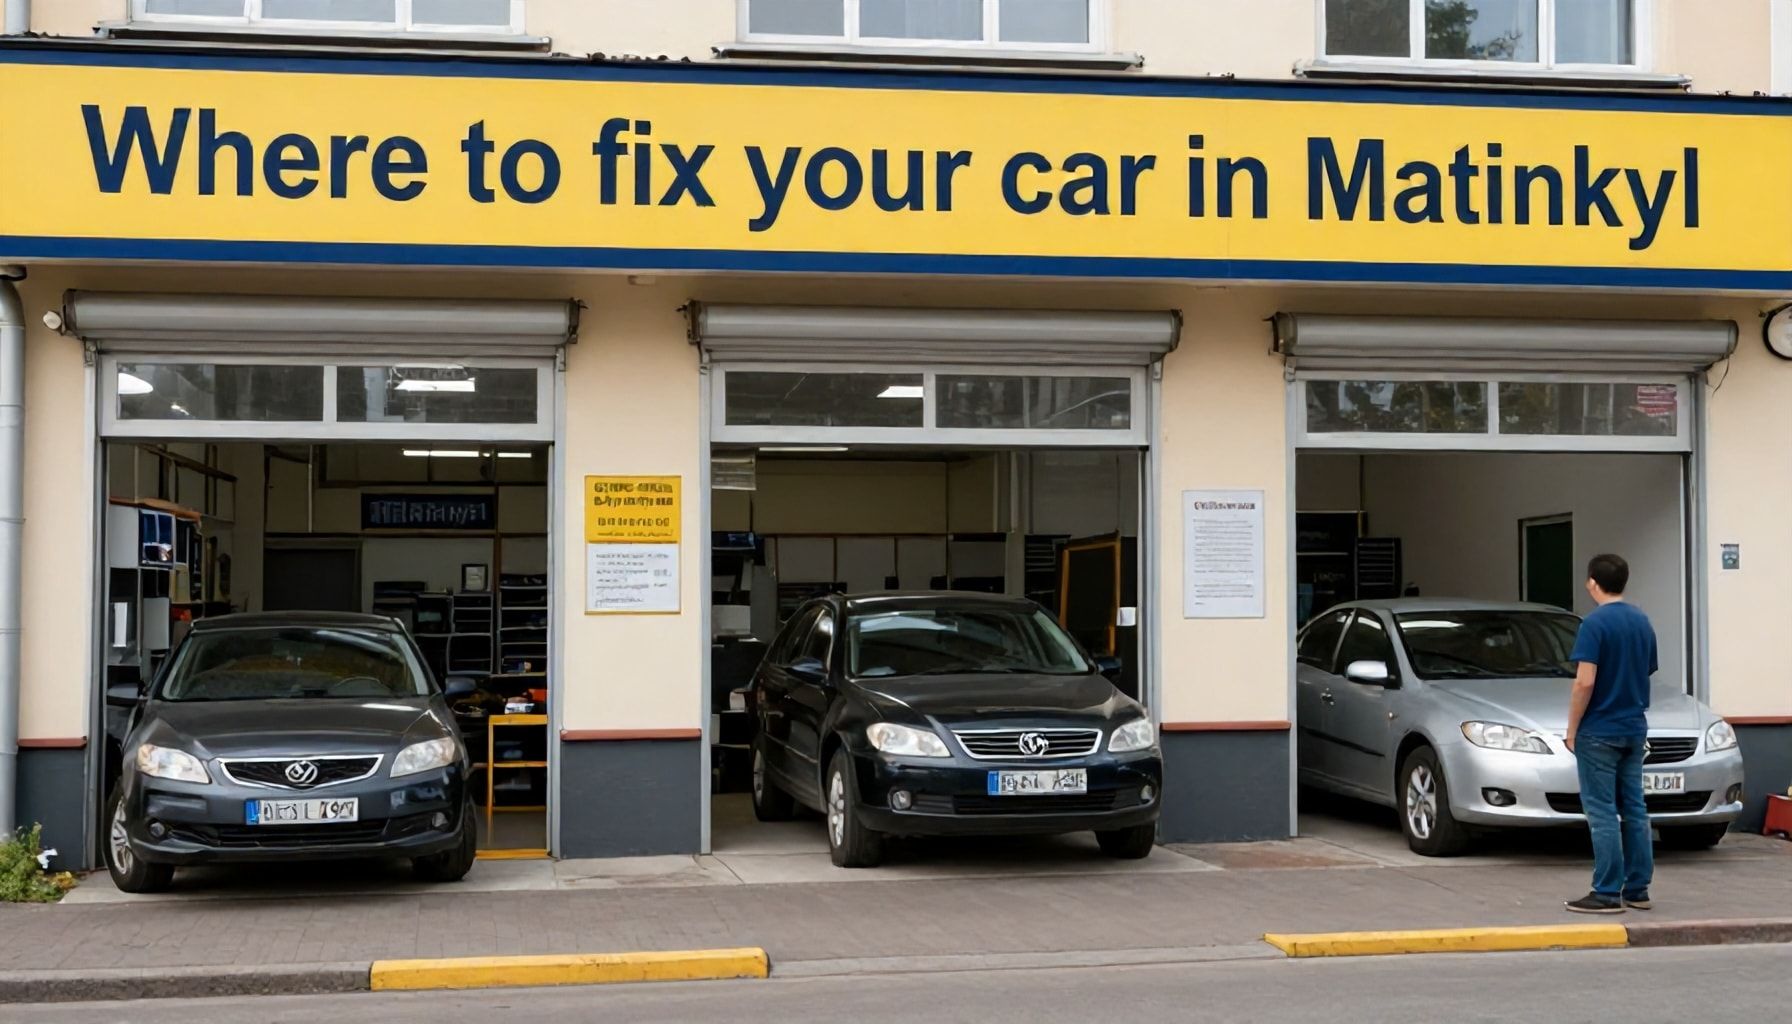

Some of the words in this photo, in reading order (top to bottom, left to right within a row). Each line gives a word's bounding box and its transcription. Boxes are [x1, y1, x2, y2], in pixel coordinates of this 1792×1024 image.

[81, 105, 427, 204] Where
[461, 120, 560, 206] to
[593, 118, 715, 208] fix
[744, 146, 972, 232] your
[1002, 152, 1156, 217] car
[1189, 135, 1267, 219] in
[1308, 137, 1698, 250] Matinkyl
